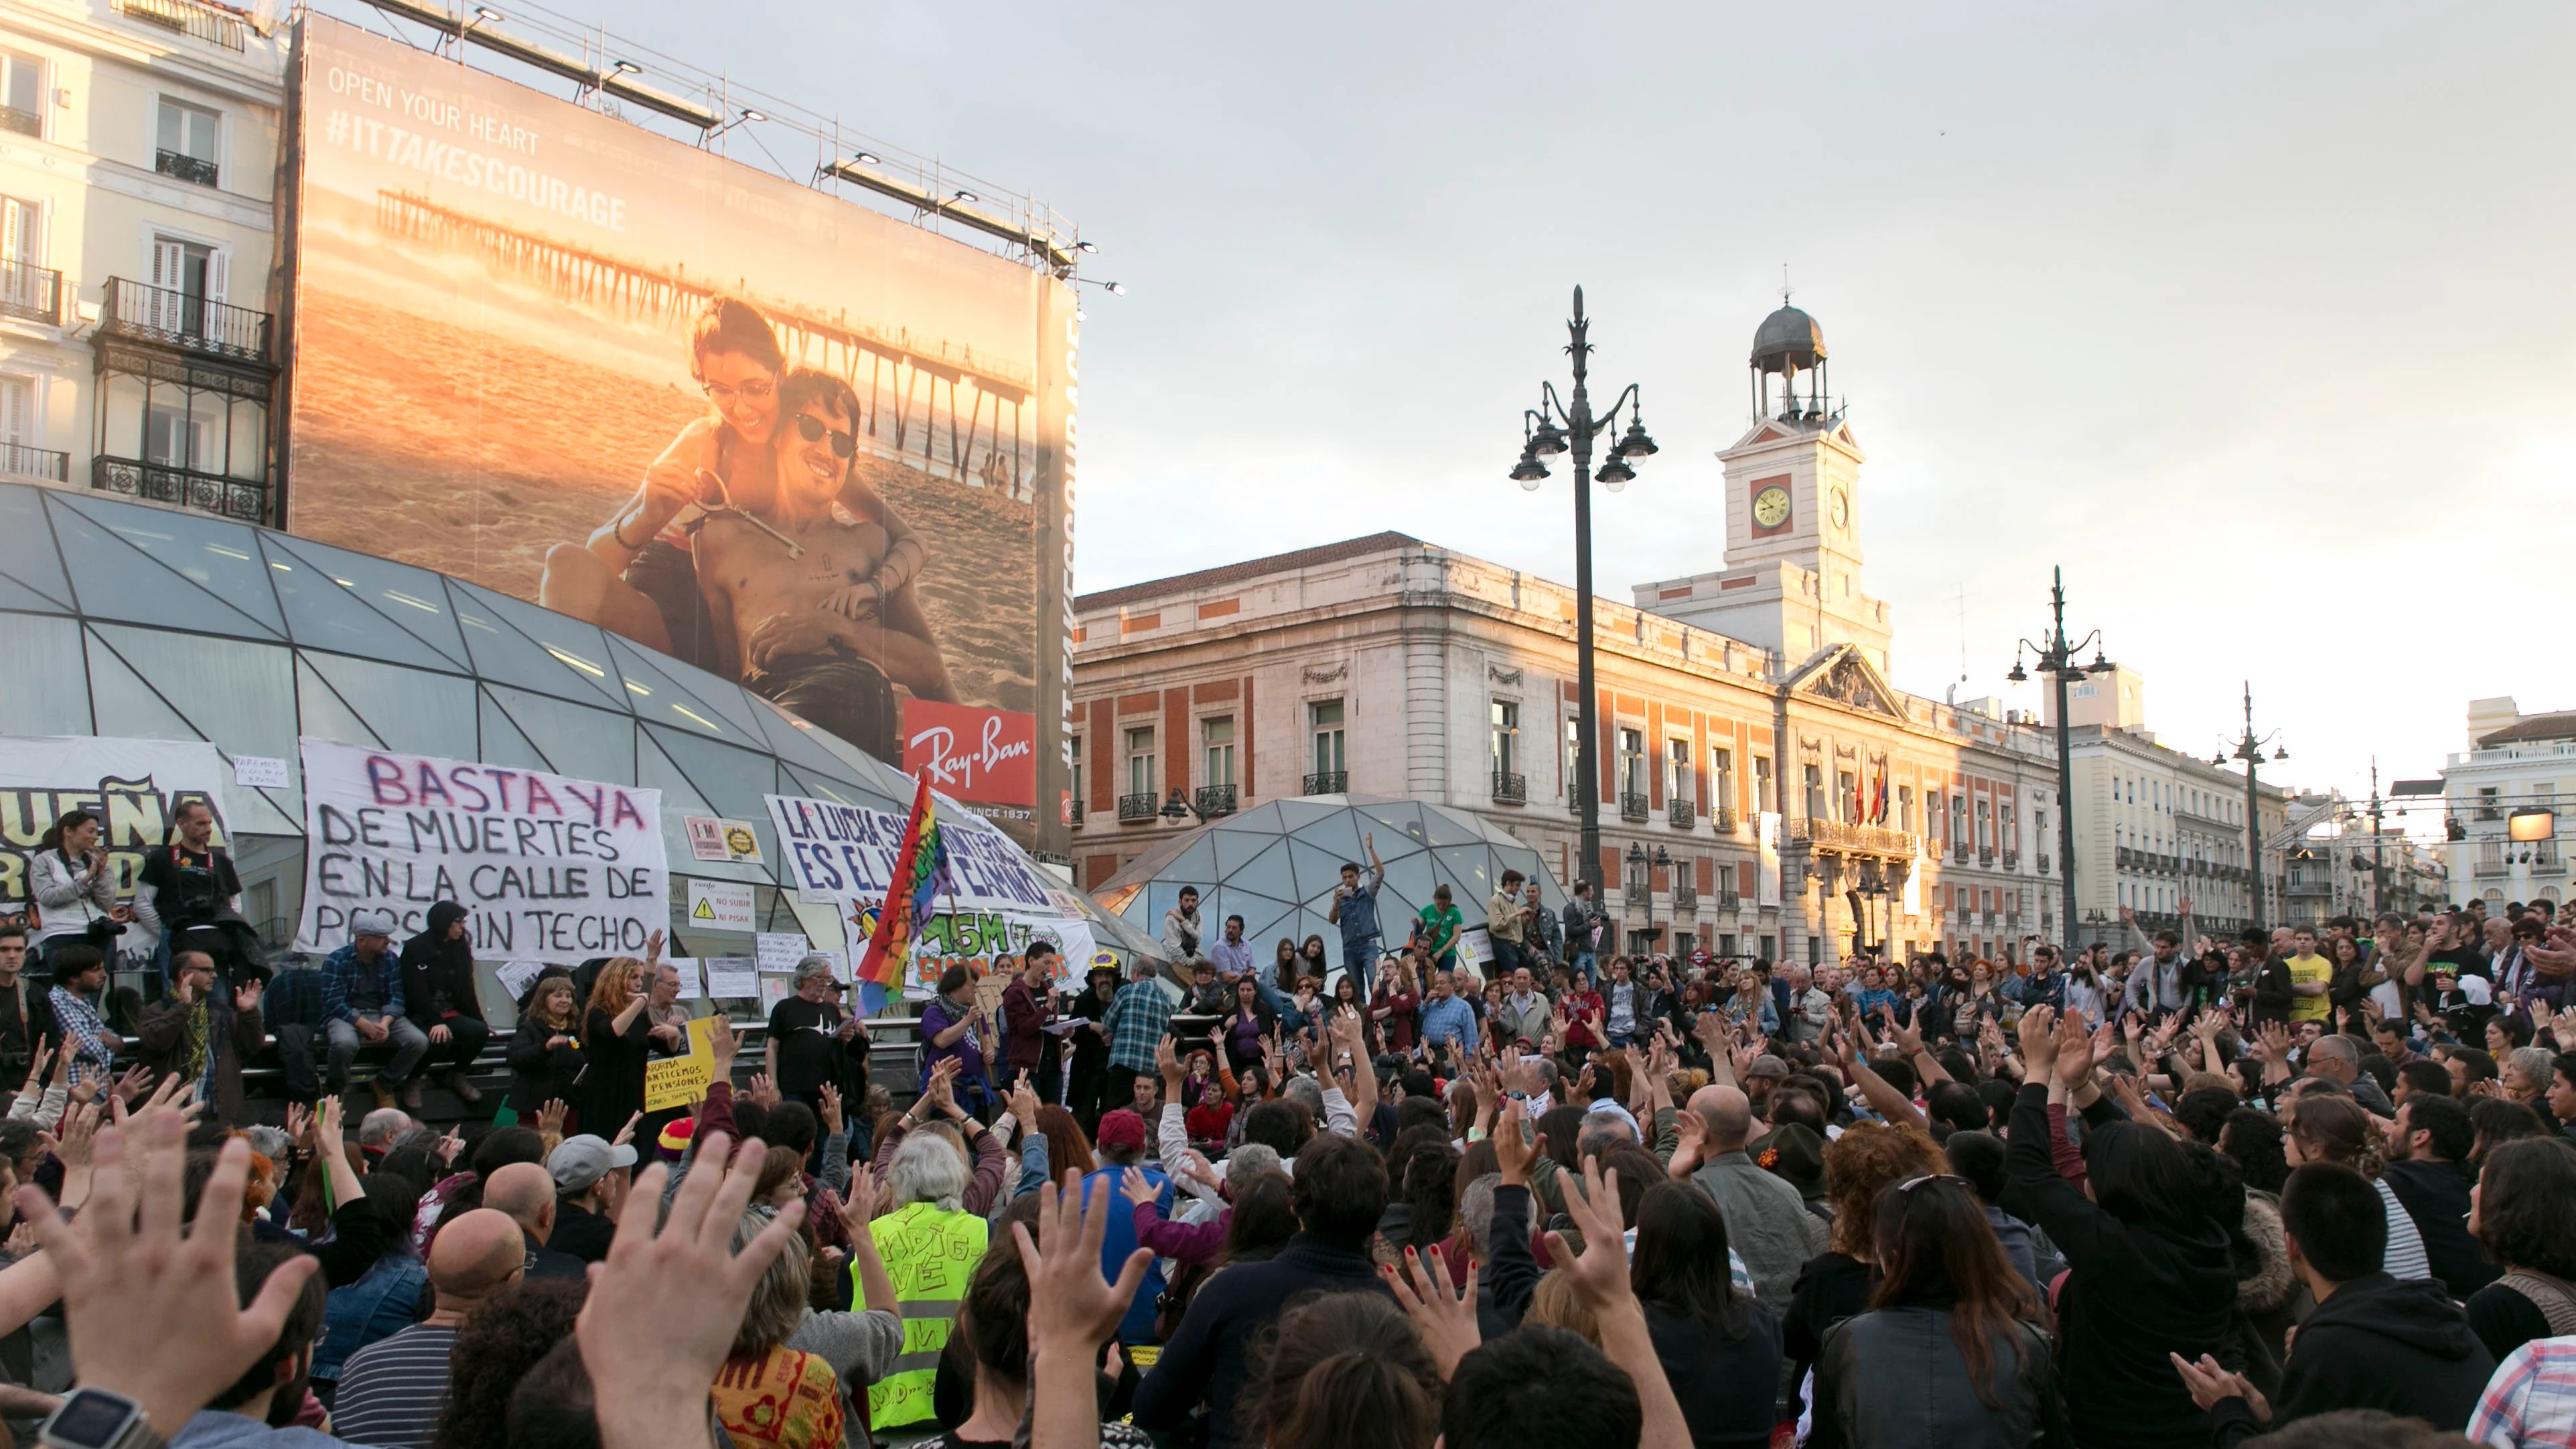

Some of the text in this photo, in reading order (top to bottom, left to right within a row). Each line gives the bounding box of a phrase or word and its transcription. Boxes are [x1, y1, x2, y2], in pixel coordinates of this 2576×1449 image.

[328, 66, 540, 156] OPEN YOUR HEART
[327, 109, 627, 233] #ITTAKESCOURAGE
[366, 754, 646, 830] BASTA YA
[966, 807, 1031, 821] SINCE 1937
[319, 804, 620, 861] DE MUERTES
[778, 799, 819, 839] LA
[814, 803, 886, 847] LUCHA
[319, 853, 654, 902] EN LA CALLE DE
[793, 842, 843, 890] ES
[841, 845, 889, 892] EL
[954, 856, 1050, 906] CAMINO
[716, 898, 751, 908] NO SUBIR
[729, 914, 749, 923] PISAR
[524, 910, 648, 952] TECHO
[922, 913, 1009, 957] 15M
